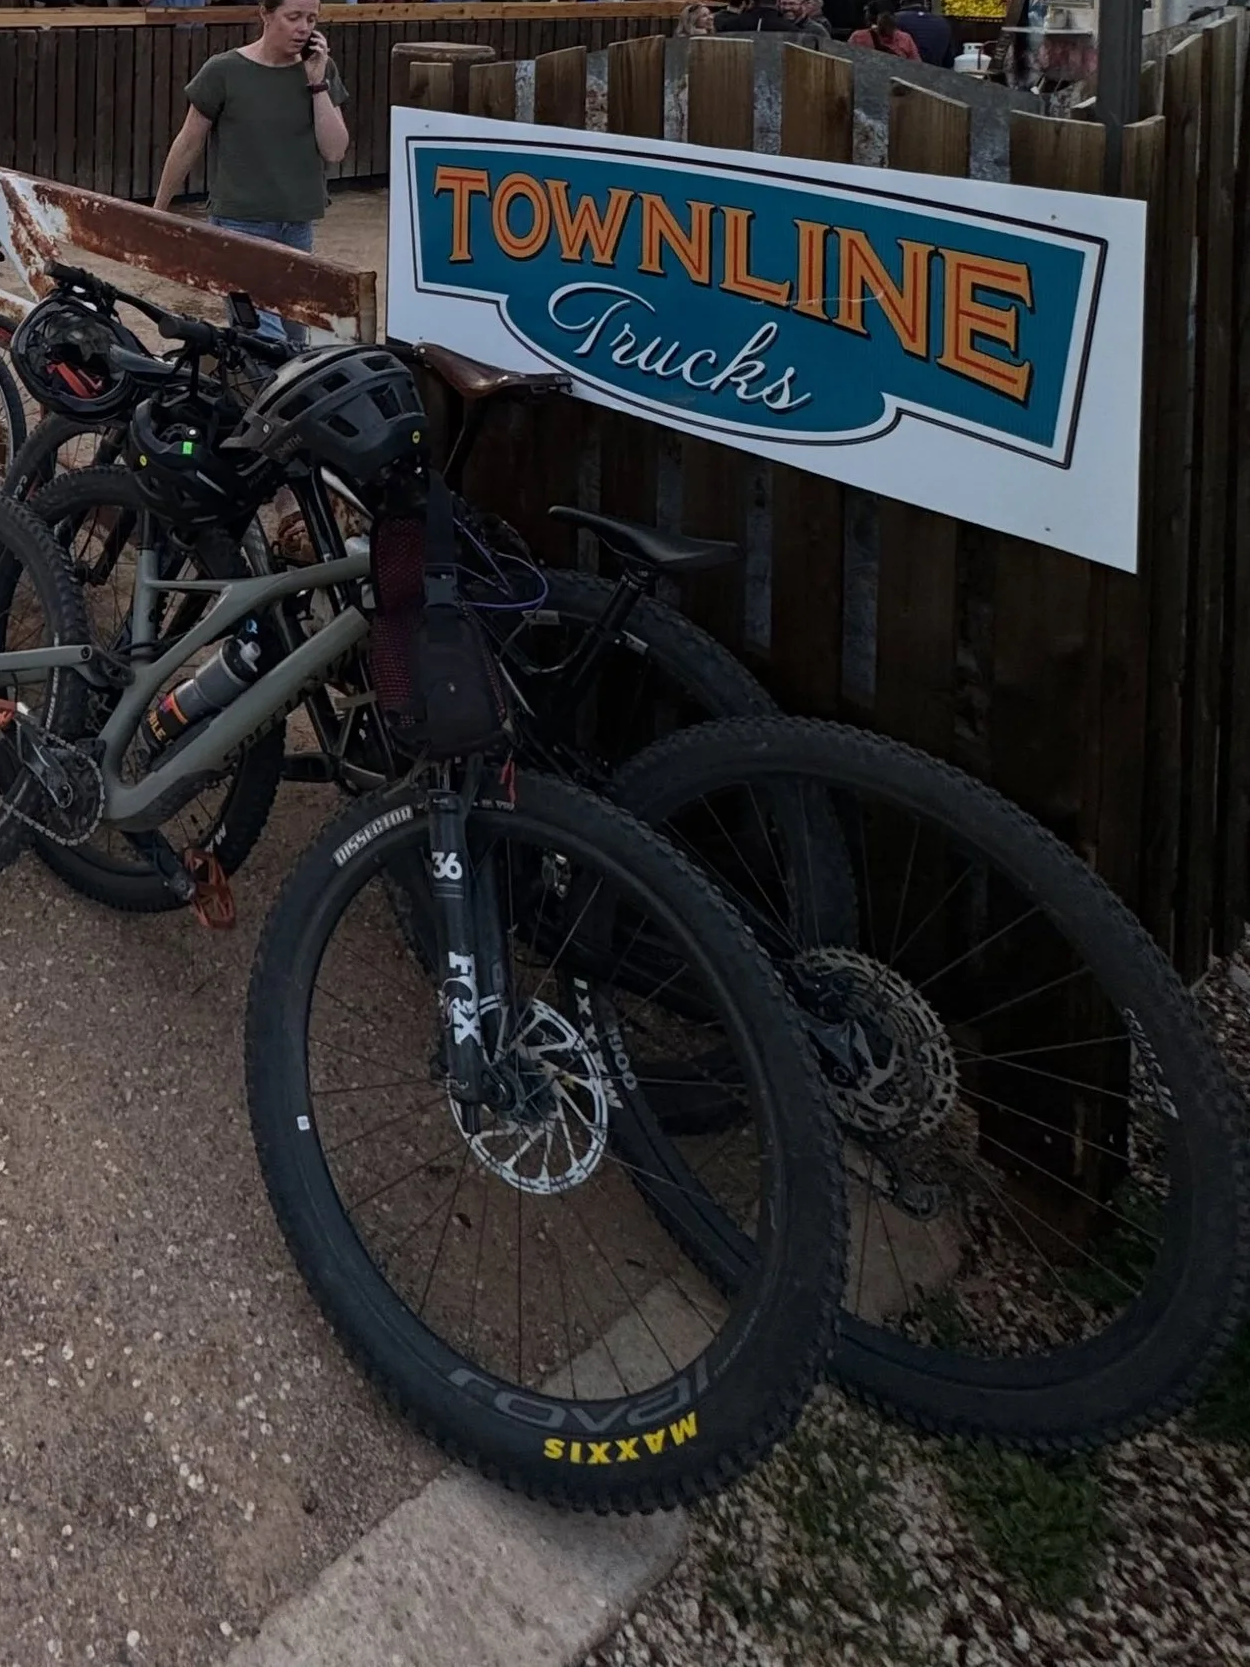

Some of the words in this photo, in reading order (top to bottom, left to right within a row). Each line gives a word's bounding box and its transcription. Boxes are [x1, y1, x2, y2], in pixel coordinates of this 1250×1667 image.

[432, 164, 1036, 407] TOWNLINE
[547, 280, 812, 412] Trucks
[332, 804, 414, 867] DISSECTOR
[431, 851, 463, 880] 36
[442, 951, 483, 1046] FOX
[573, 977, 624, 1109] MAXXI
[543, 1411, 698, 1465] MAXXIS
